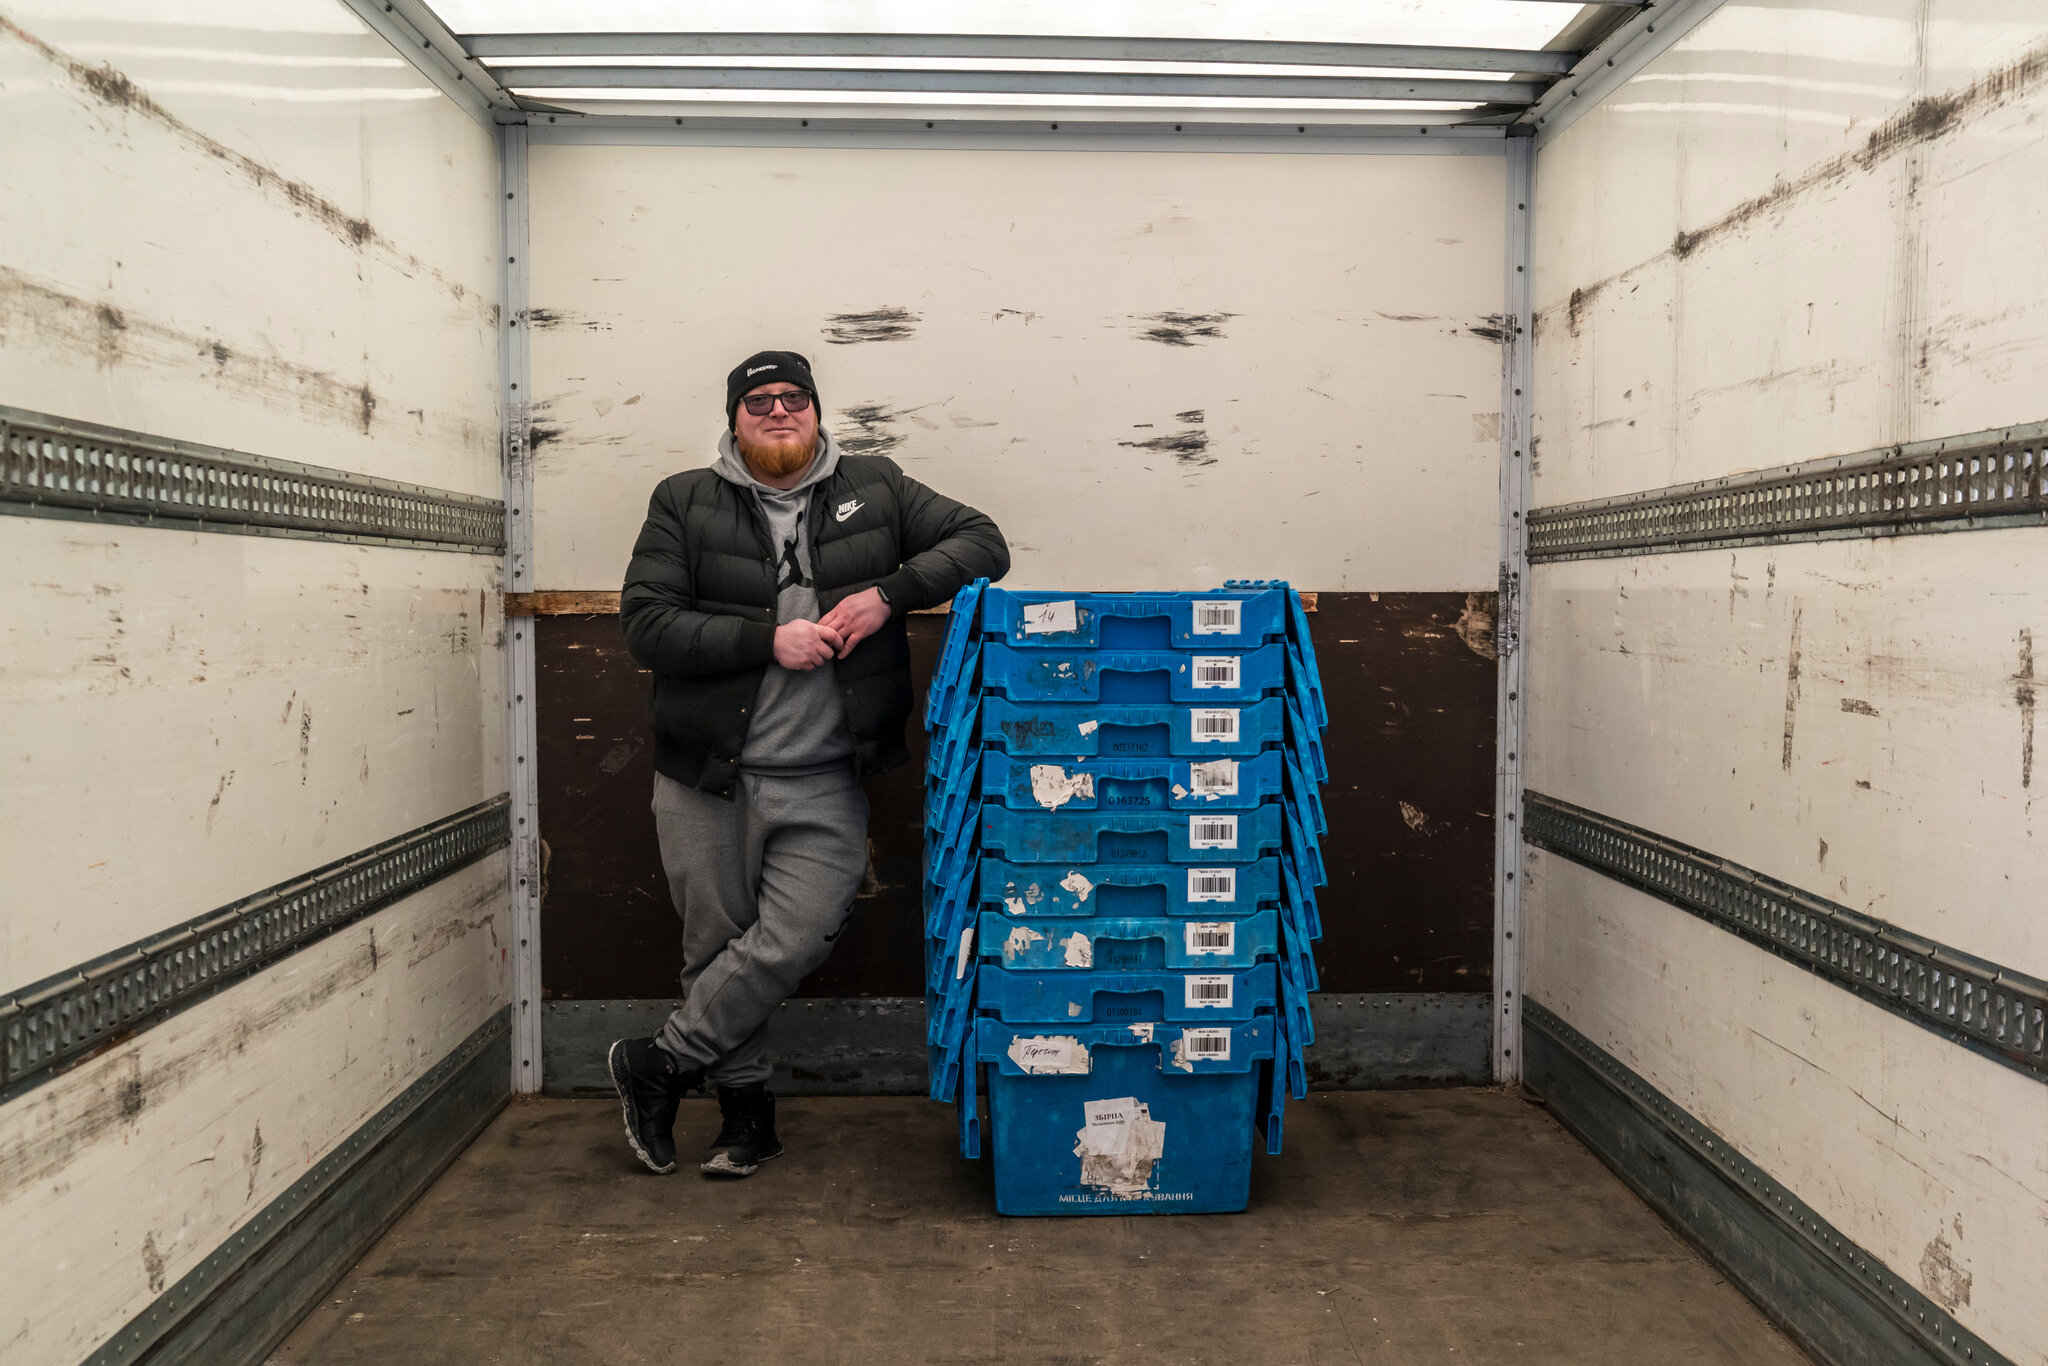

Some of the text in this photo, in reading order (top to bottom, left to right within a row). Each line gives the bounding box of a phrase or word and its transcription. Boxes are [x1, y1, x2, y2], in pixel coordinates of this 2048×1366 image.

[838, 499, 857, 514] NIKE
[1108, 796, 1151, 806] 0163725
[1058, 1194, 1092, 1203] МІСЦЕ
